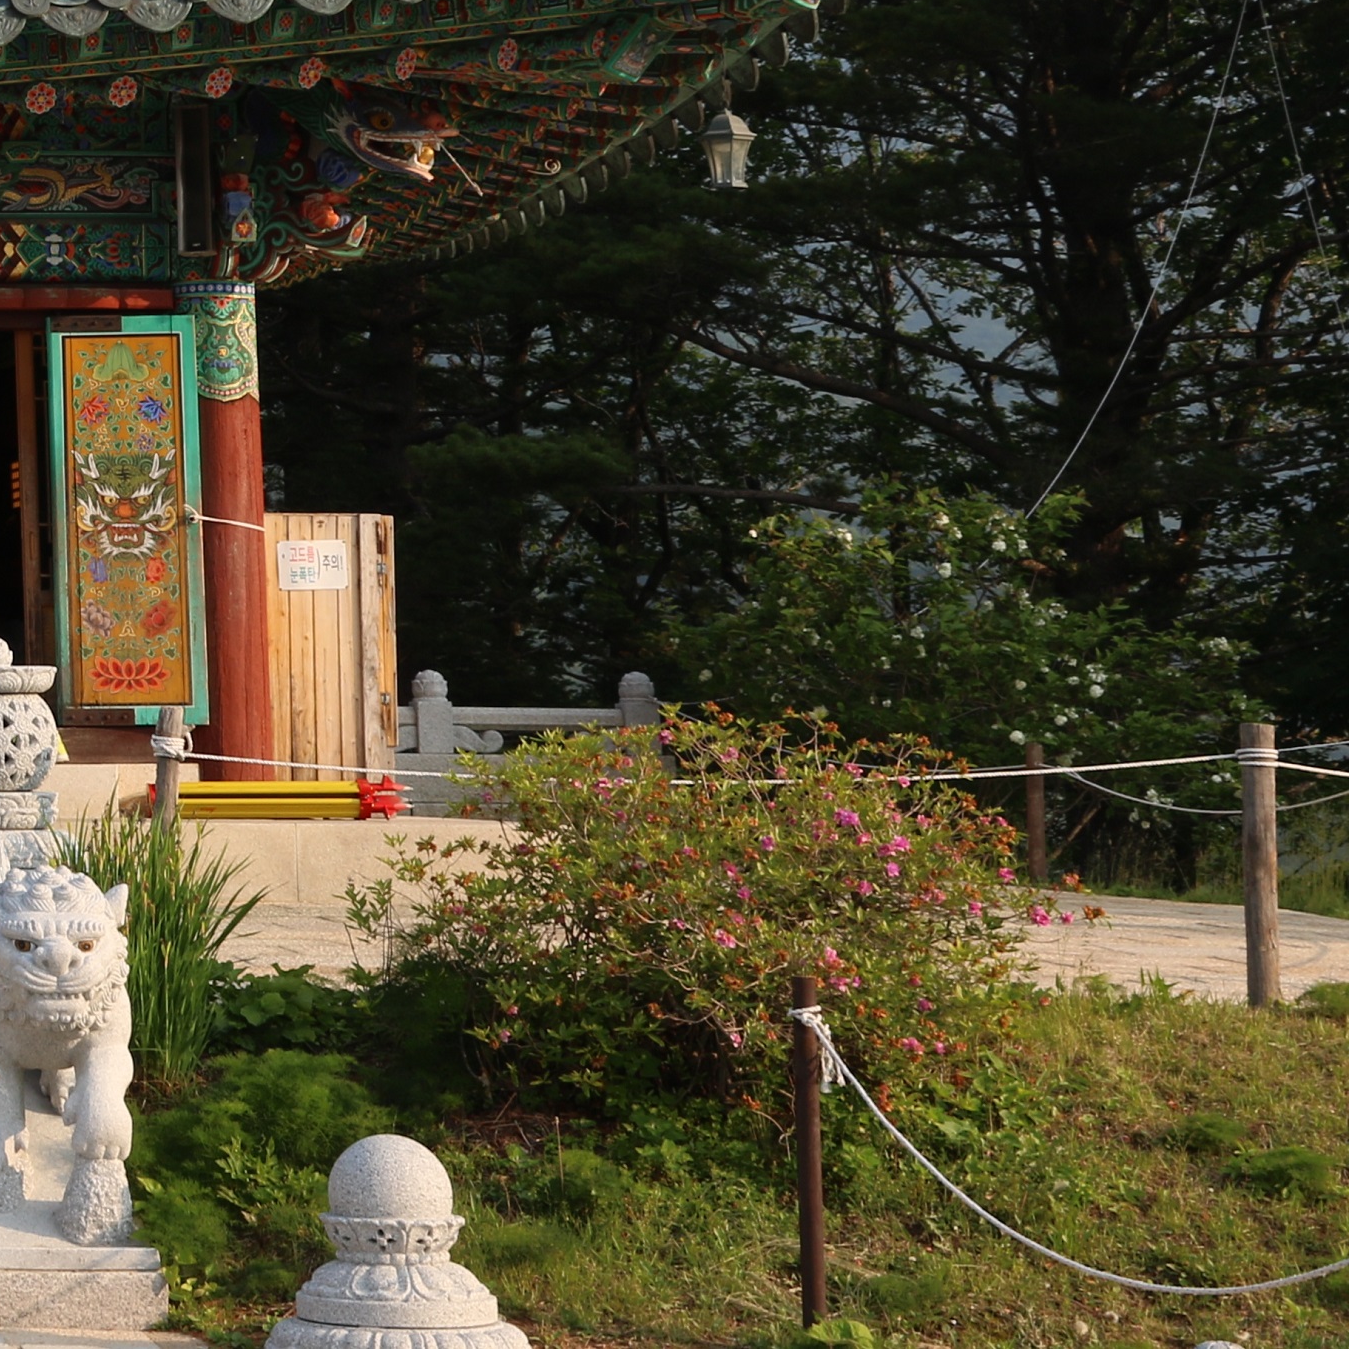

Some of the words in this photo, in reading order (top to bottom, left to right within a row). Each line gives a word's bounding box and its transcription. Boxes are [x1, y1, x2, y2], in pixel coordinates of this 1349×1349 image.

[289, 546, 314, 563] 고드름
[322, 554, 343, 571] 주의!
[290, 566, 316, 583] 눈폭탄
